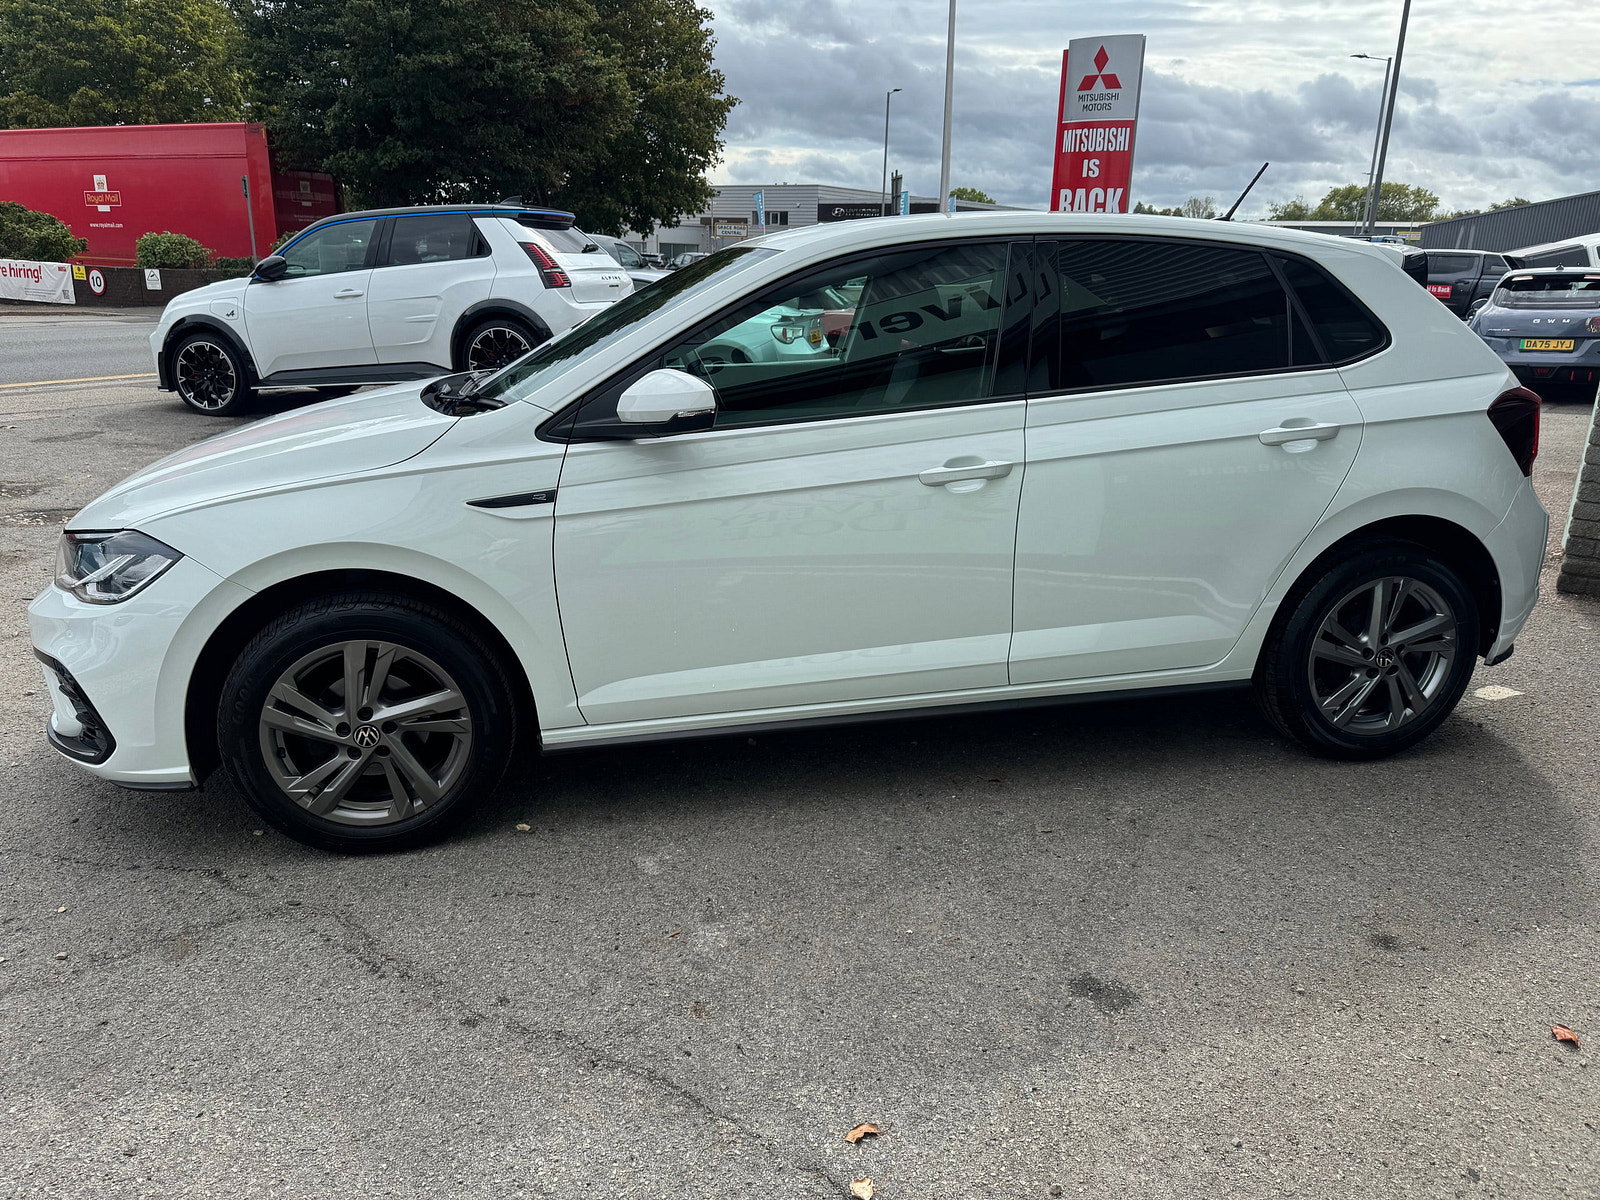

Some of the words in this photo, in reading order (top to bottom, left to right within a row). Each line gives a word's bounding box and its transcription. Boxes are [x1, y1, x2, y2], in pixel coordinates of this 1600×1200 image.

[1078, 93, 1119, 102] MITSUBISHI
[1082, 103, 1112, 112] MOTORS
[1062, 127, 1131, 153] MITSUBISHI
[1082, 159, 1100, 178] IS
[86, 193, 104, 204] Royal
[105, 193, 119, 203] Mail
[1058, 187, 1124, 214] BACK
[0, 266, 7, 277] e
[9, 263, 43, 283] hiring!
[91, 276, 102, 287] 10
[1525, 340, 1551, 349] DA75
[1552, 340, 1573, 349] JYJ
